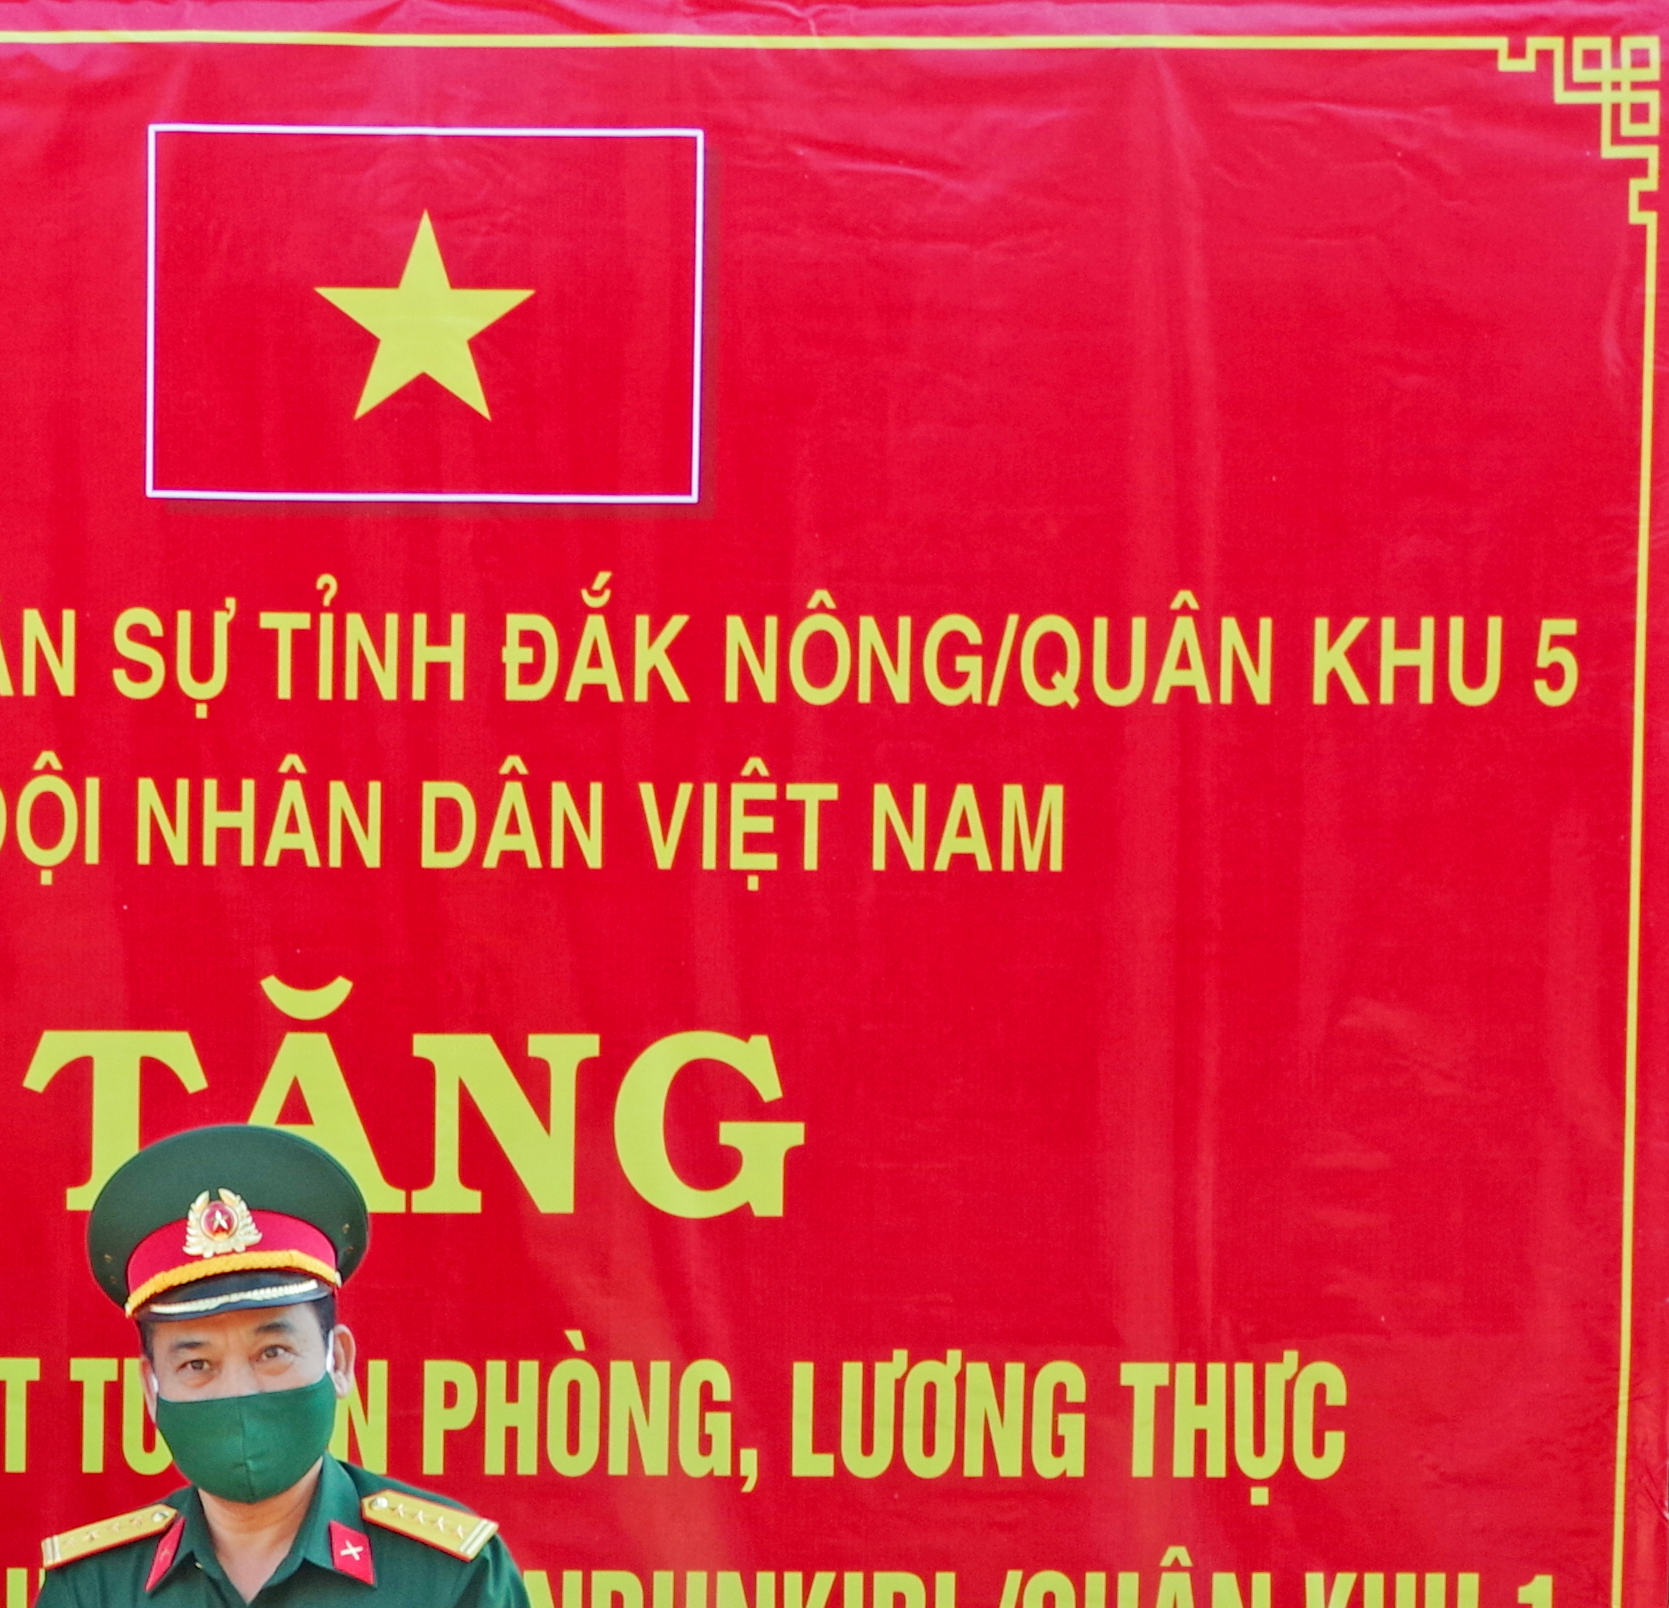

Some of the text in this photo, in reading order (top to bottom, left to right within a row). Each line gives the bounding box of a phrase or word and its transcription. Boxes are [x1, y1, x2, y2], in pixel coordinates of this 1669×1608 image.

[112, 597, 237, 718] SỰ
[259, 574, 466, 701] TỈNH
[501, 571, 690, 703] ĐẮK
[724, 589, 1273, 708] NÔNG/QUÂN
[1312, 615, 1503, 707] KHU
[1533, 618, 1579, 707] 5
[137, 754, 382, 869] NHÂN
[420, 755, 603, 870] DÂN
[638, 756, 839, 891] VIỆT
[872, 783, 1064, 872] NAM
[422, 1329, 759, 1491] PHÒNG,
[791, 1348, 1087, 1480] LƯƠNG
[1119, 1349, 1348, 1506] THỰC
